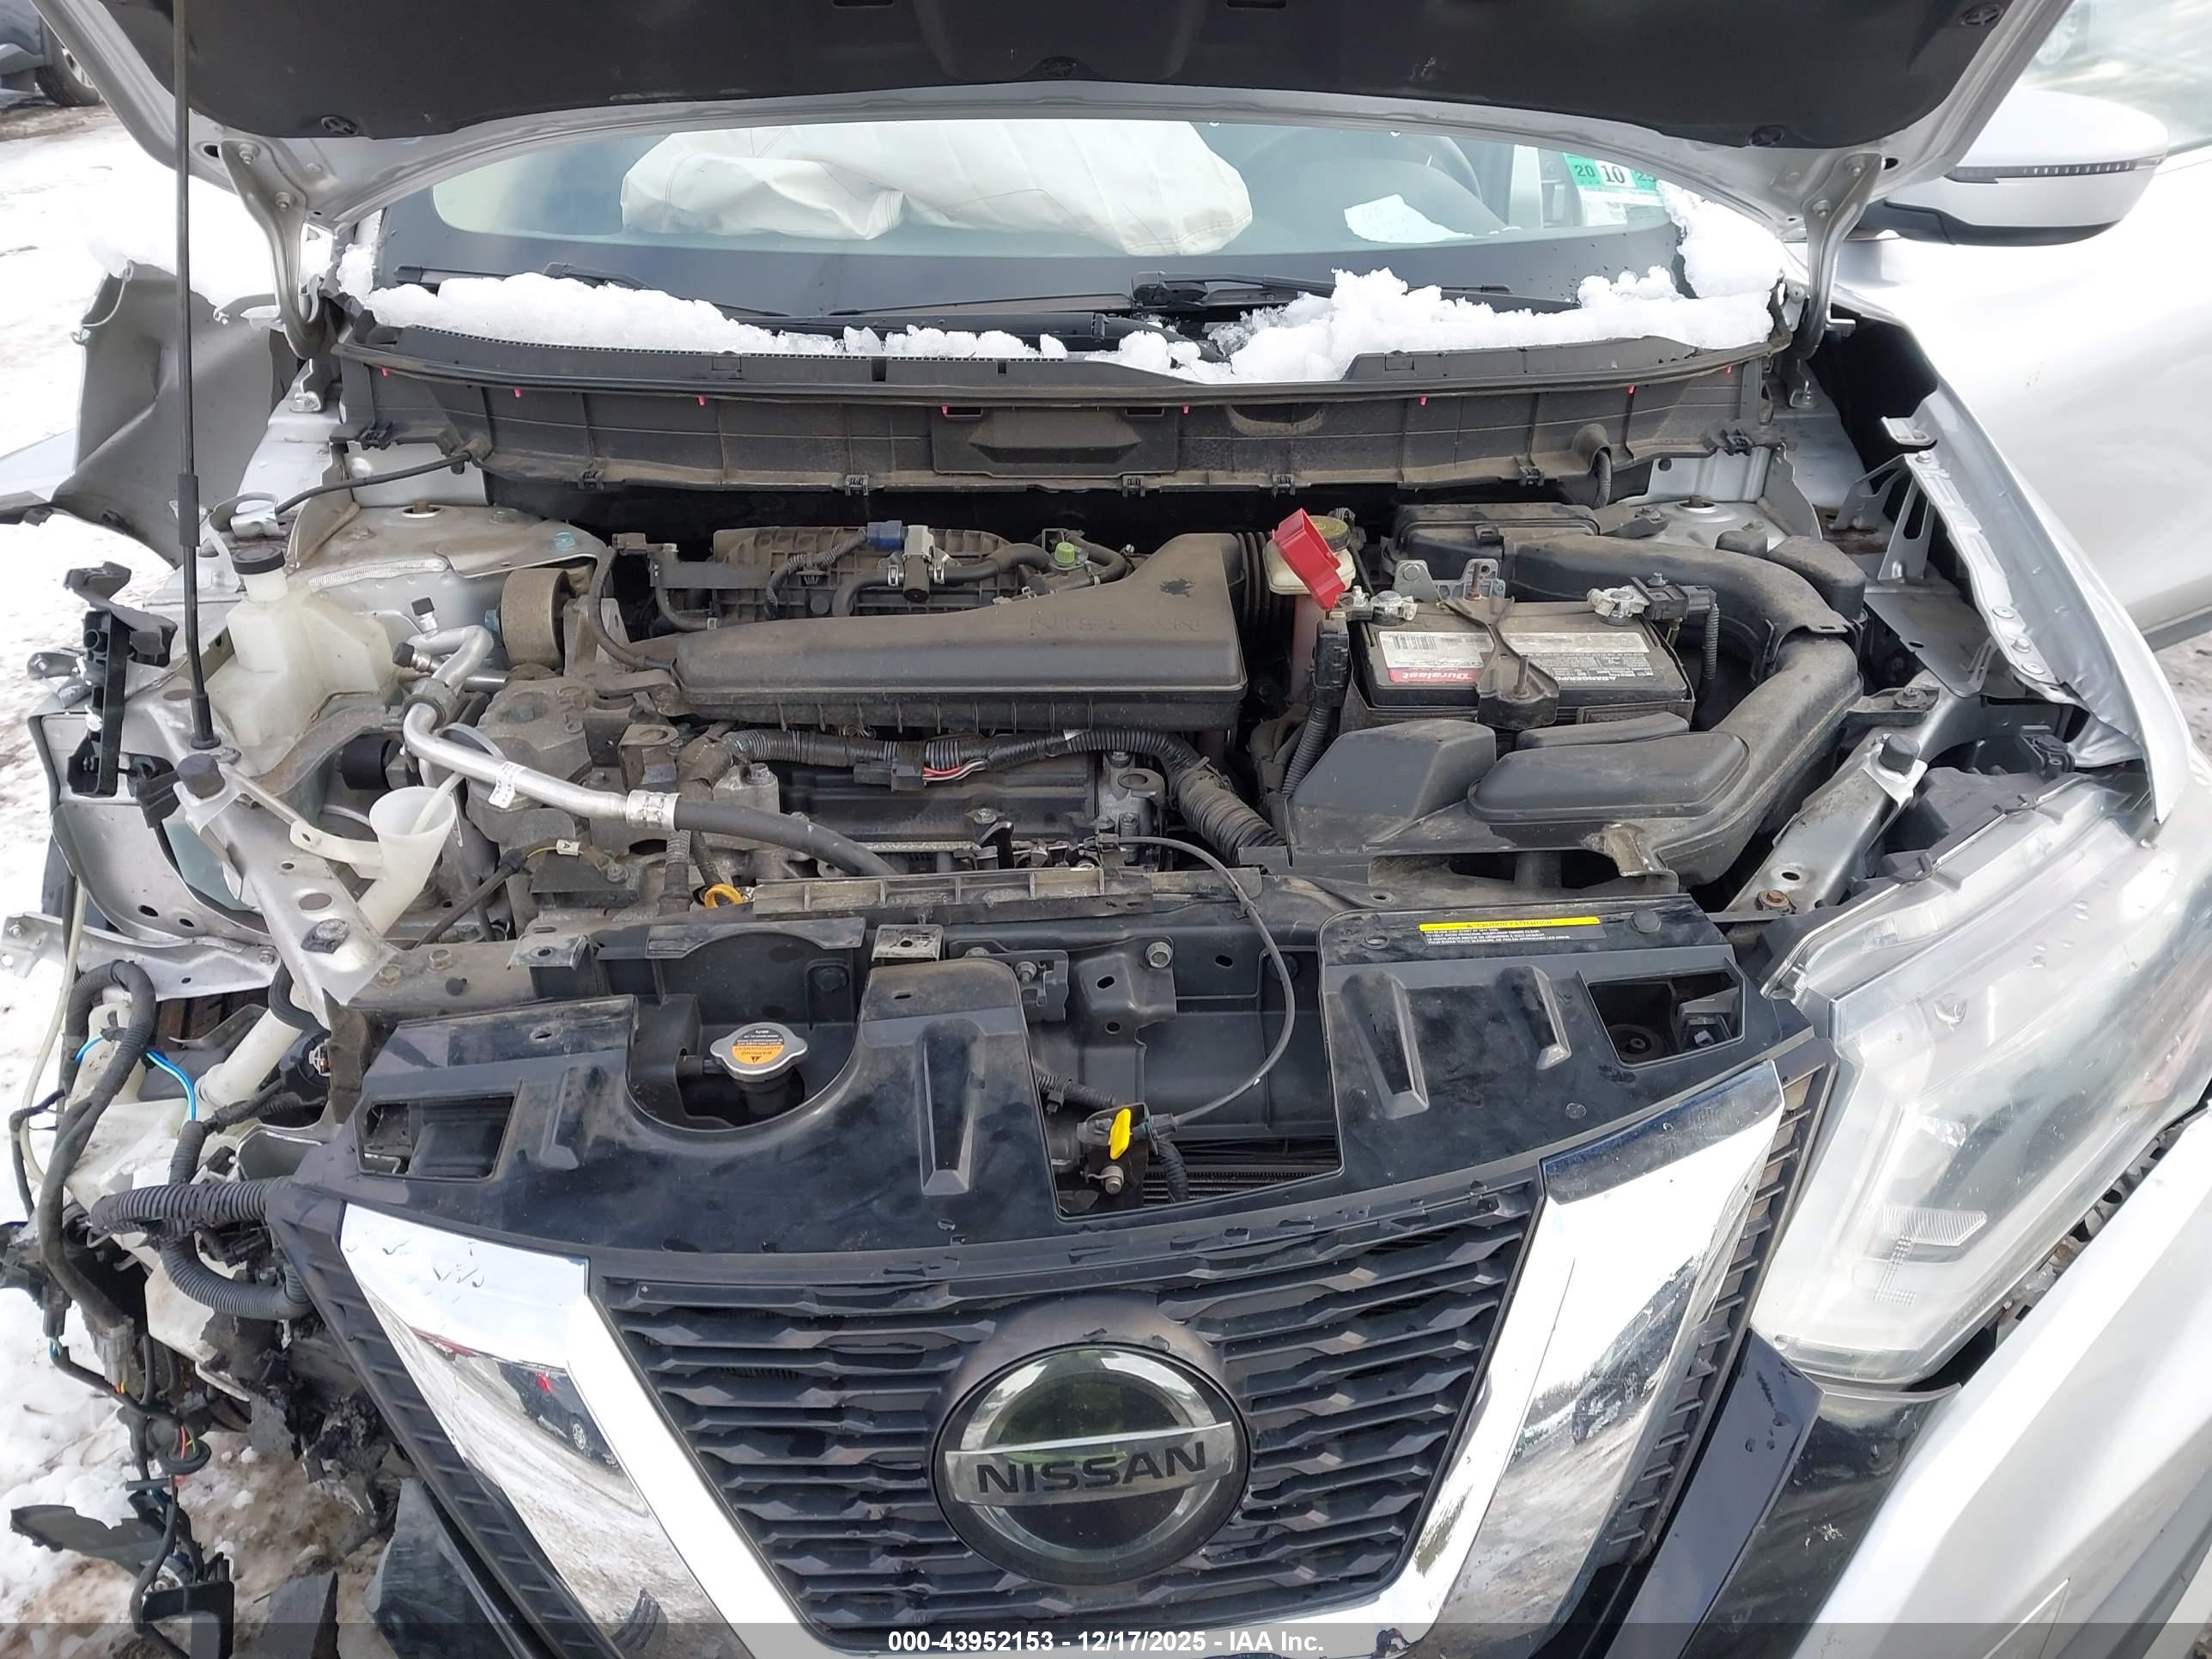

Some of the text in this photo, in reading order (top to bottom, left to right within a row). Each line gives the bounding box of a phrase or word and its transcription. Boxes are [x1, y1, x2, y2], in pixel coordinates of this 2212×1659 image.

[1575, 164, 1595, 178] 20
[1601, 164, 1626, 184] 10
[1401, 672, 1473, 680] Duralast
[977, 1441, 1206, 1494] NISSAN
